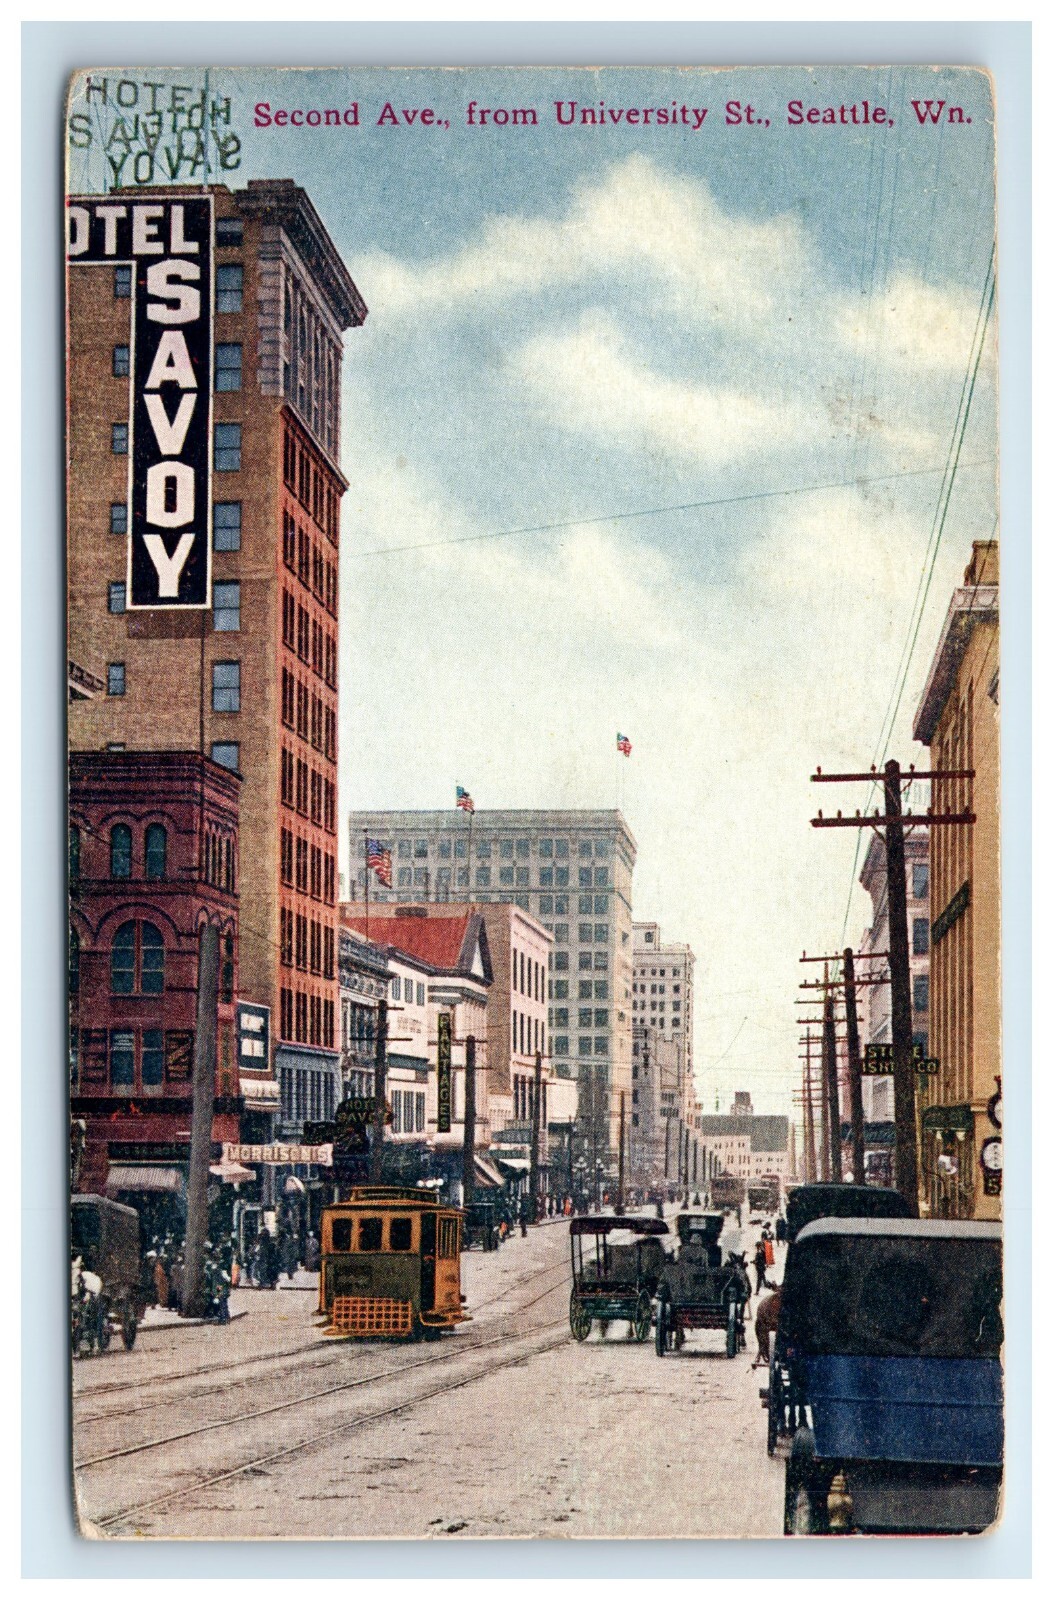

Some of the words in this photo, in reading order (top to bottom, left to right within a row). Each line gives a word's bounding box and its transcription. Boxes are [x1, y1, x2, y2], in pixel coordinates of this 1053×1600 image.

[85, 76, 207, 114] HOTEL
[143, 258, 202, 598] SAVOY
[438, 1013, 450, 1130] PANTAGES
